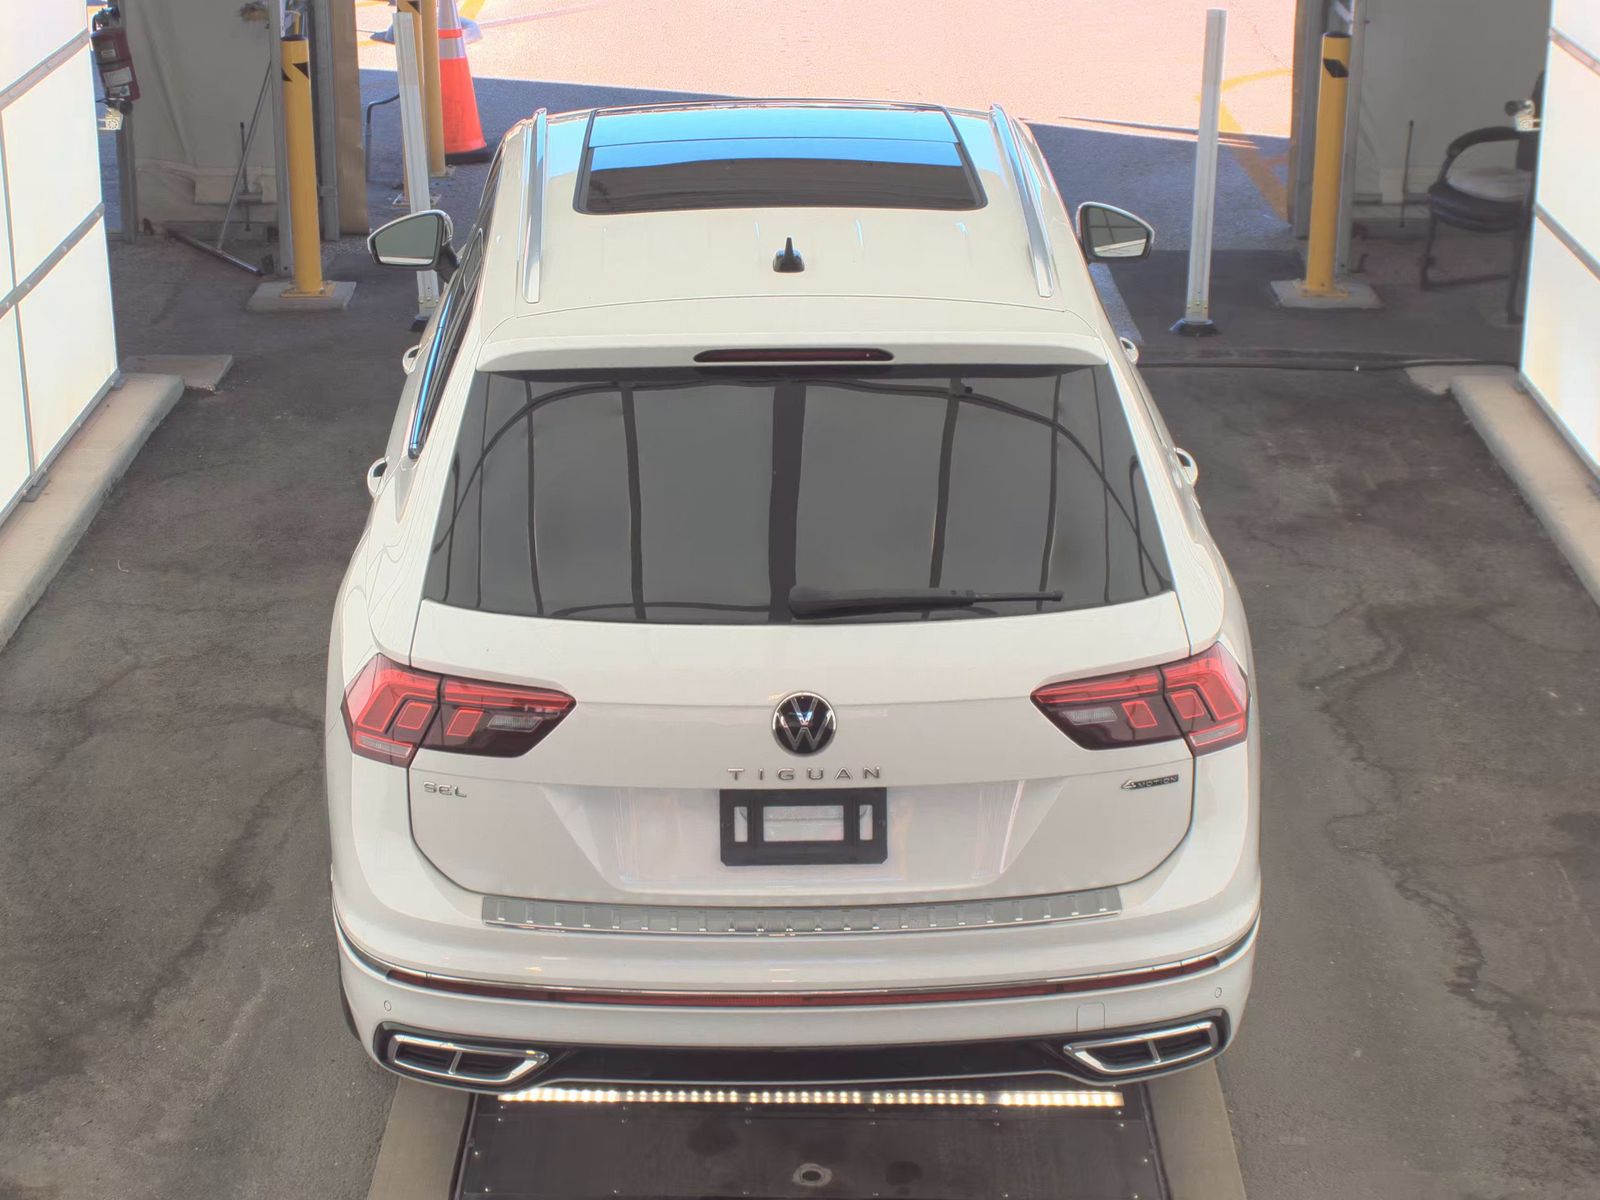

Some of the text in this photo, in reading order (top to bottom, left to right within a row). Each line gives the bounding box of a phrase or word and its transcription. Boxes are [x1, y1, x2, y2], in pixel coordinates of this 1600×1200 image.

[774, 694, 835, 754] VW
[727, 766, 881, 781] TIGUAN
[423, 781, 468, 798] SEL
[1120, 774, 1179, 790] 4MOTION
